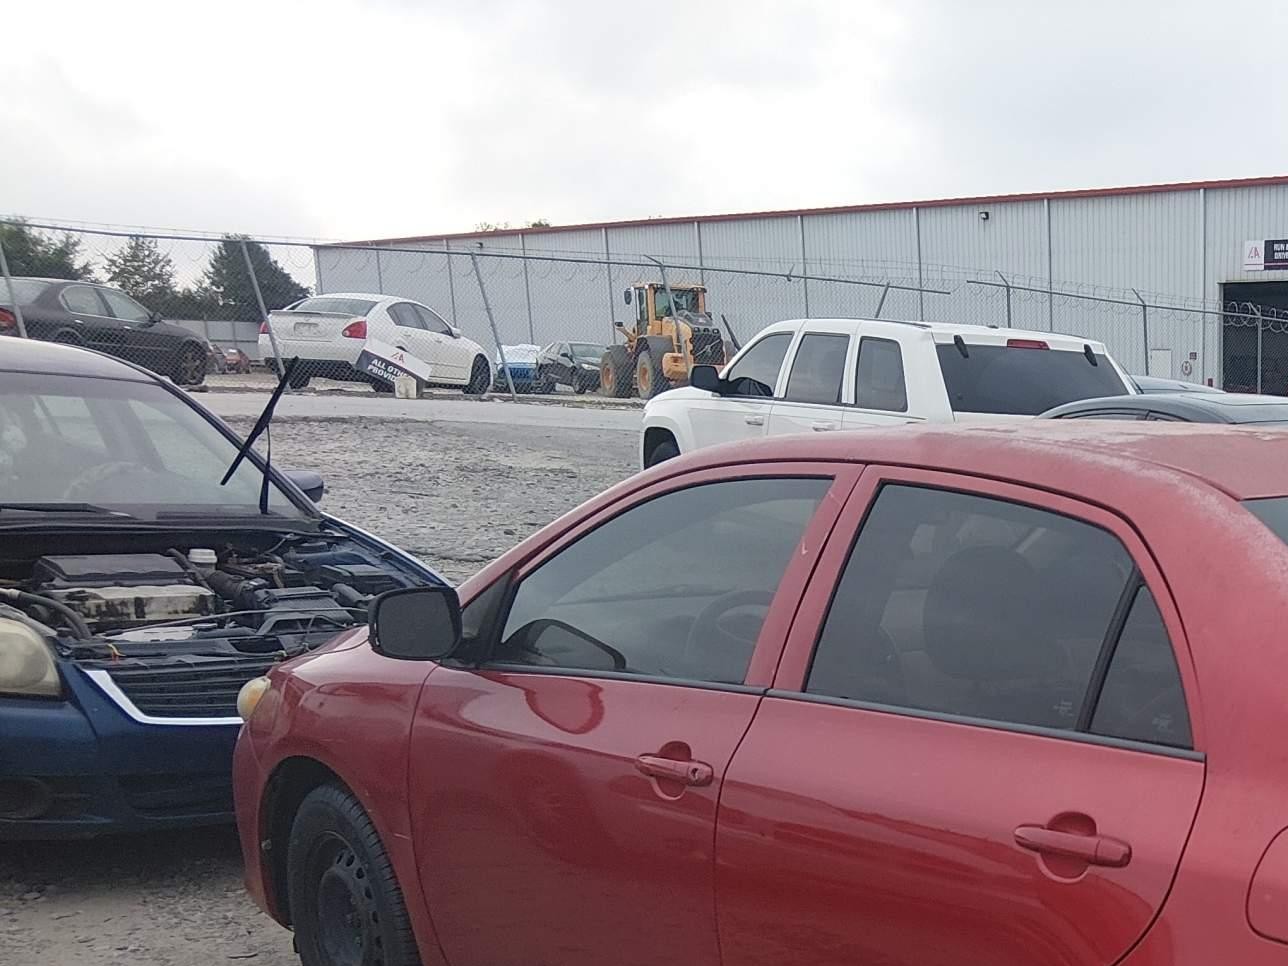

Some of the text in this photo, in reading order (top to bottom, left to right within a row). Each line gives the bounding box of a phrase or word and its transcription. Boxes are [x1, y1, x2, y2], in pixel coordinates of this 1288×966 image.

[1273, 243, 1285, 251] RUN
[371, 358, 387, 370] ALL
[367, 364, 397, 382] PROVID
